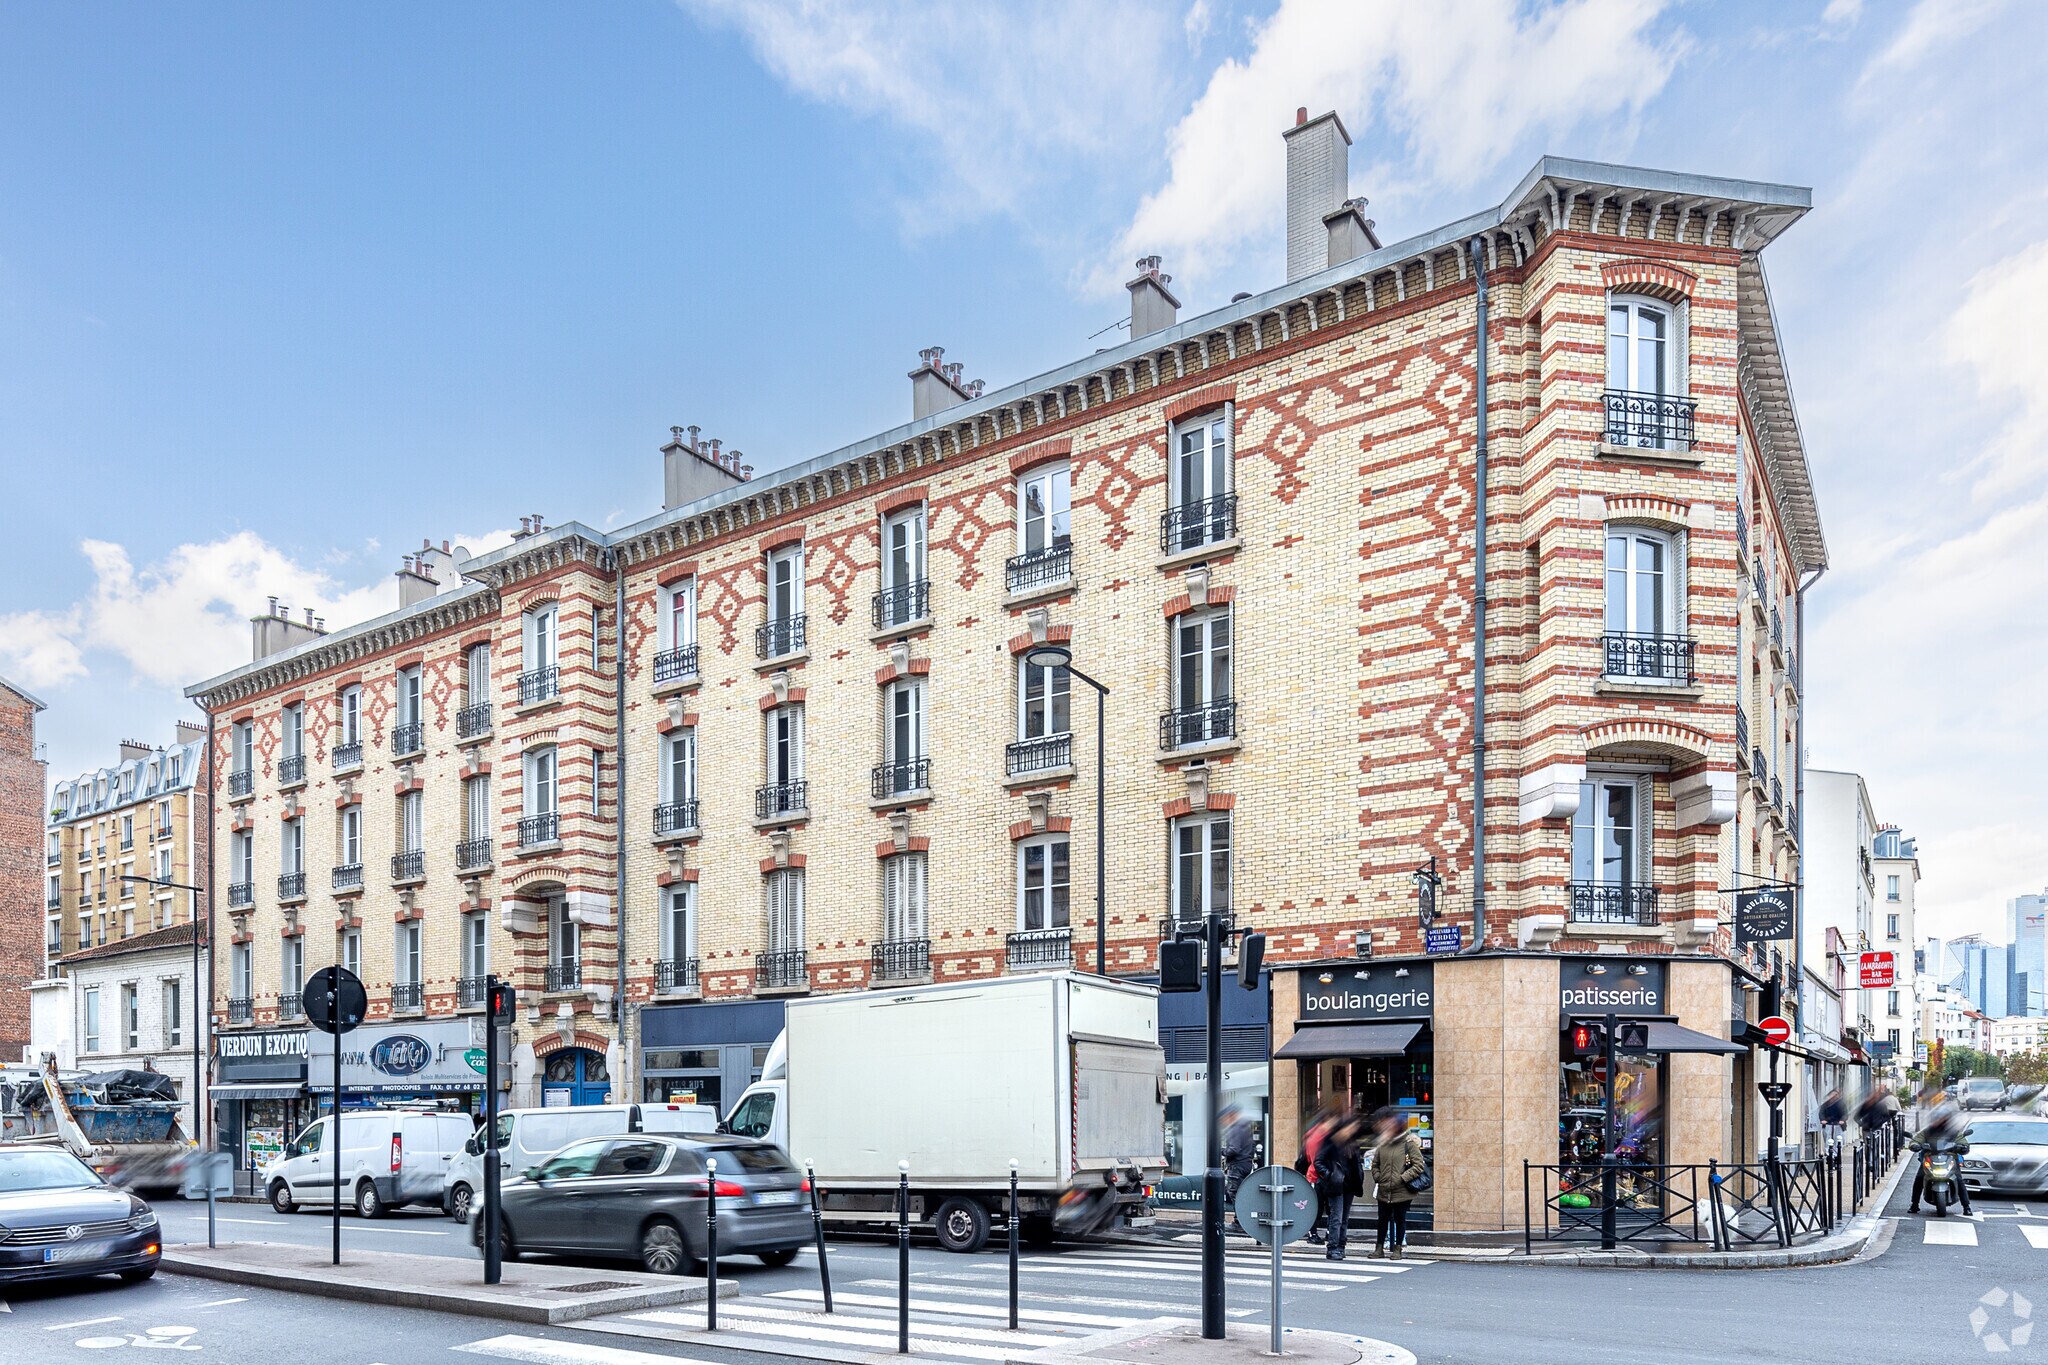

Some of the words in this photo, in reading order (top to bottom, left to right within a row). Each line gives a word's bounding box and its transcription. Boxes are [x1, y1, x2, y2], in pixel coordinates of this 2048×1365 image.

[1743, 897, 1788, 913] BOULANGERIE
[1742, 920, 1788, 937] ARTISANALE
[1306, 989, 1430, 1012] boulangerie
[1562, 986, 1657, 1008] patisserie
[220, 1036, 262, 1057] VERDUN
[265, 1033, 308, 1058] EXOTIQ
[1195, 1072, 1230, 1080] BAS
[321, 1096, 334, 1104] LEBA
[1150, 1190, 1202, 1200] rences.fr
